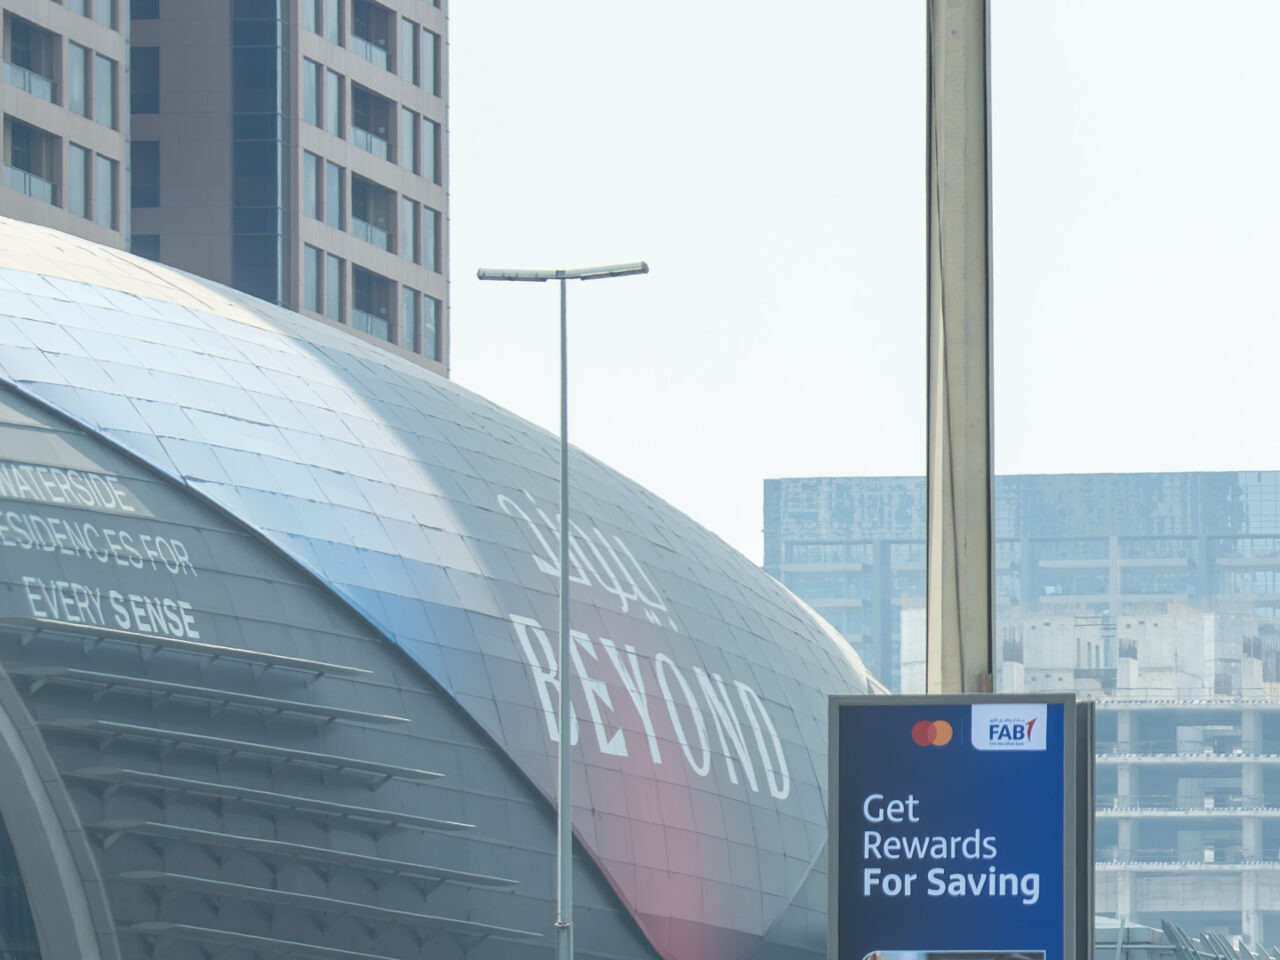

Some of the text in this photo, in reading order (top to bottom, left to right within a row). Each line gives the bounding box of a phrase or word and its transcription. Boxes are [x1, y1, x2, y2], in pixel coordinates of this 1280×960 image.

[0, 462, 135, 512] WATERSIDE
[0, 510, 198, 577] ESIDENCES FOR
[22, 576, 200, 639] EVERY SENSE
[509, 613, 791, 800] BEYOND
[989, 724, 1025, 740] FAB
[863, 794, 920, 822] Get
[863, 828, 997, 859] Rewards
[863, 866, 1040, 905] For Saving
